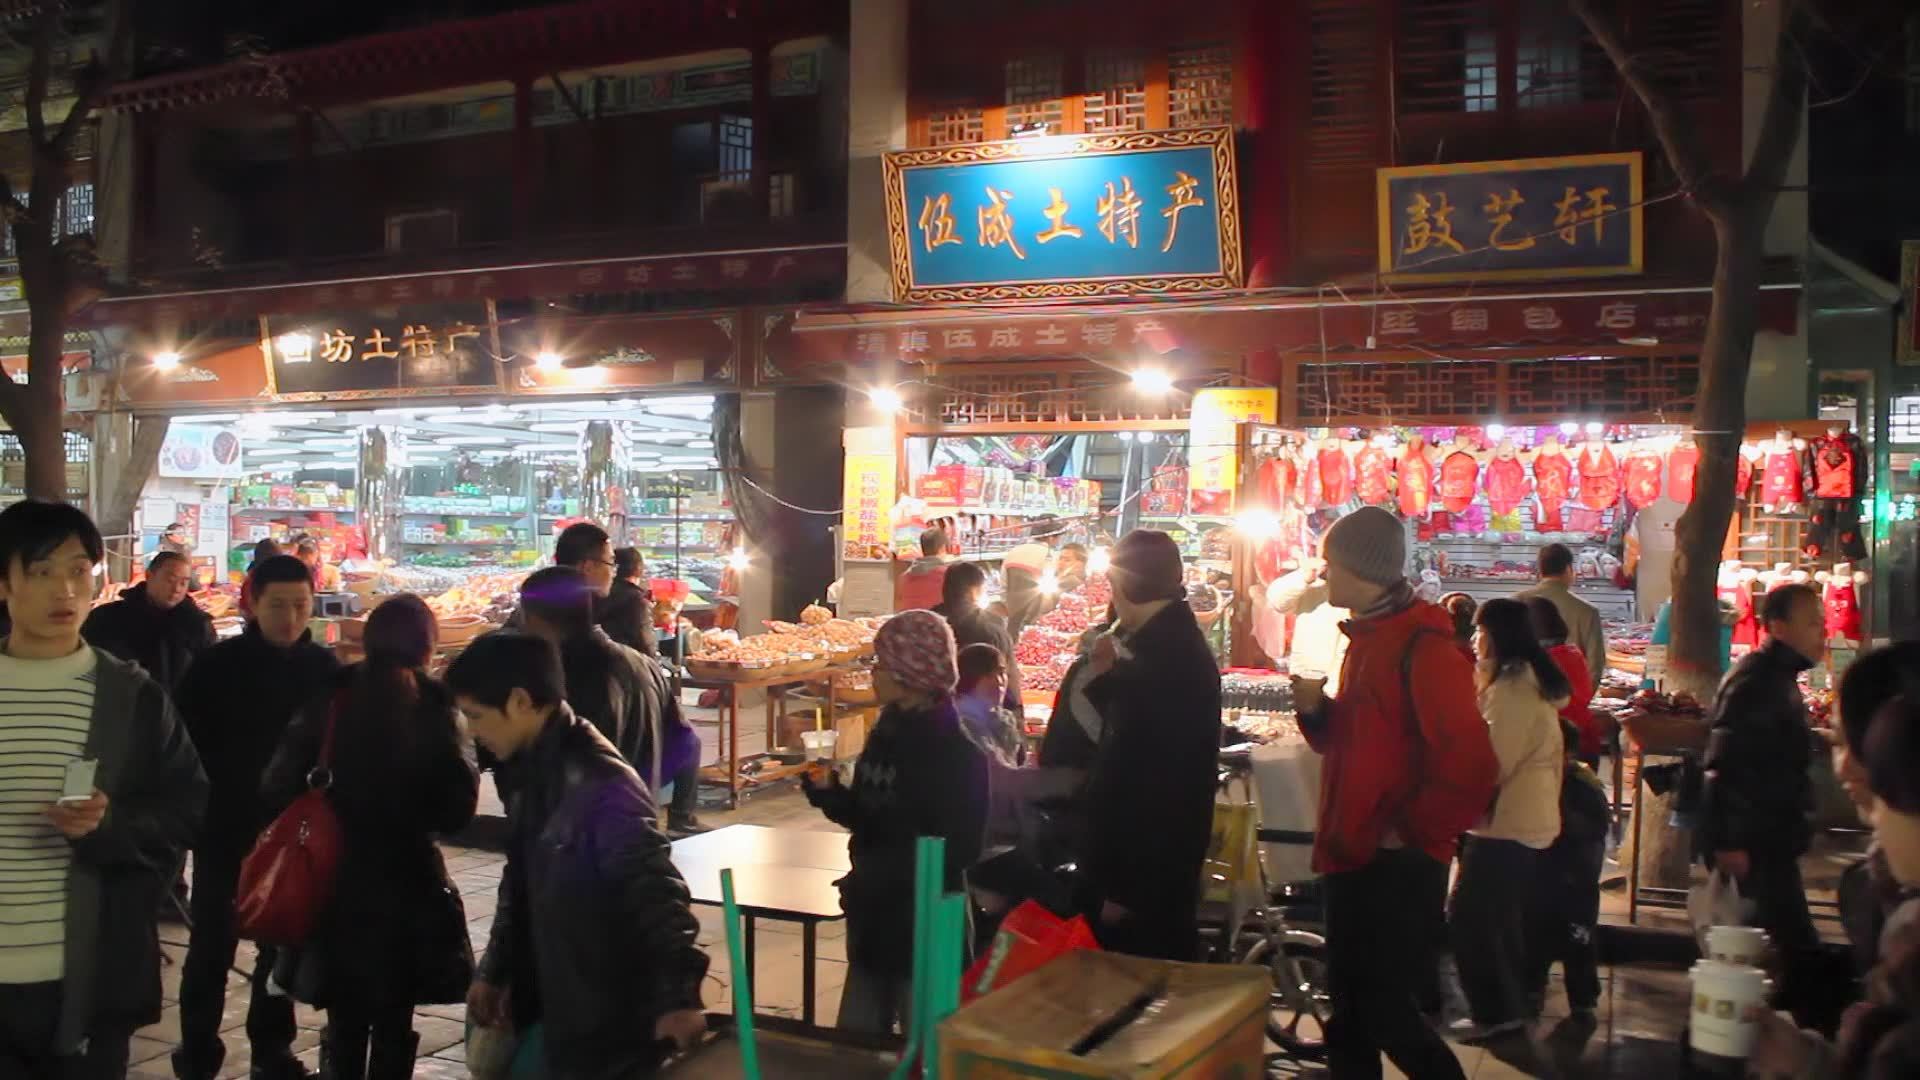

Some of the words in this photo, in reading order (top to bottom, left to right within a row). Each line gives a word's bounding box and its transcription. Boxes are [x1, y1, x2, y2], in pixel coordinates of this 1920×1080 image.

[917, 170, 1206, 260] 伍成土特产
[1404, 185, 1617, 254] 鼓艺轩
[856, 320, 1167, 354] 清真伍成土特产
[1380, 301, 1637, 336] 丝绸包店
